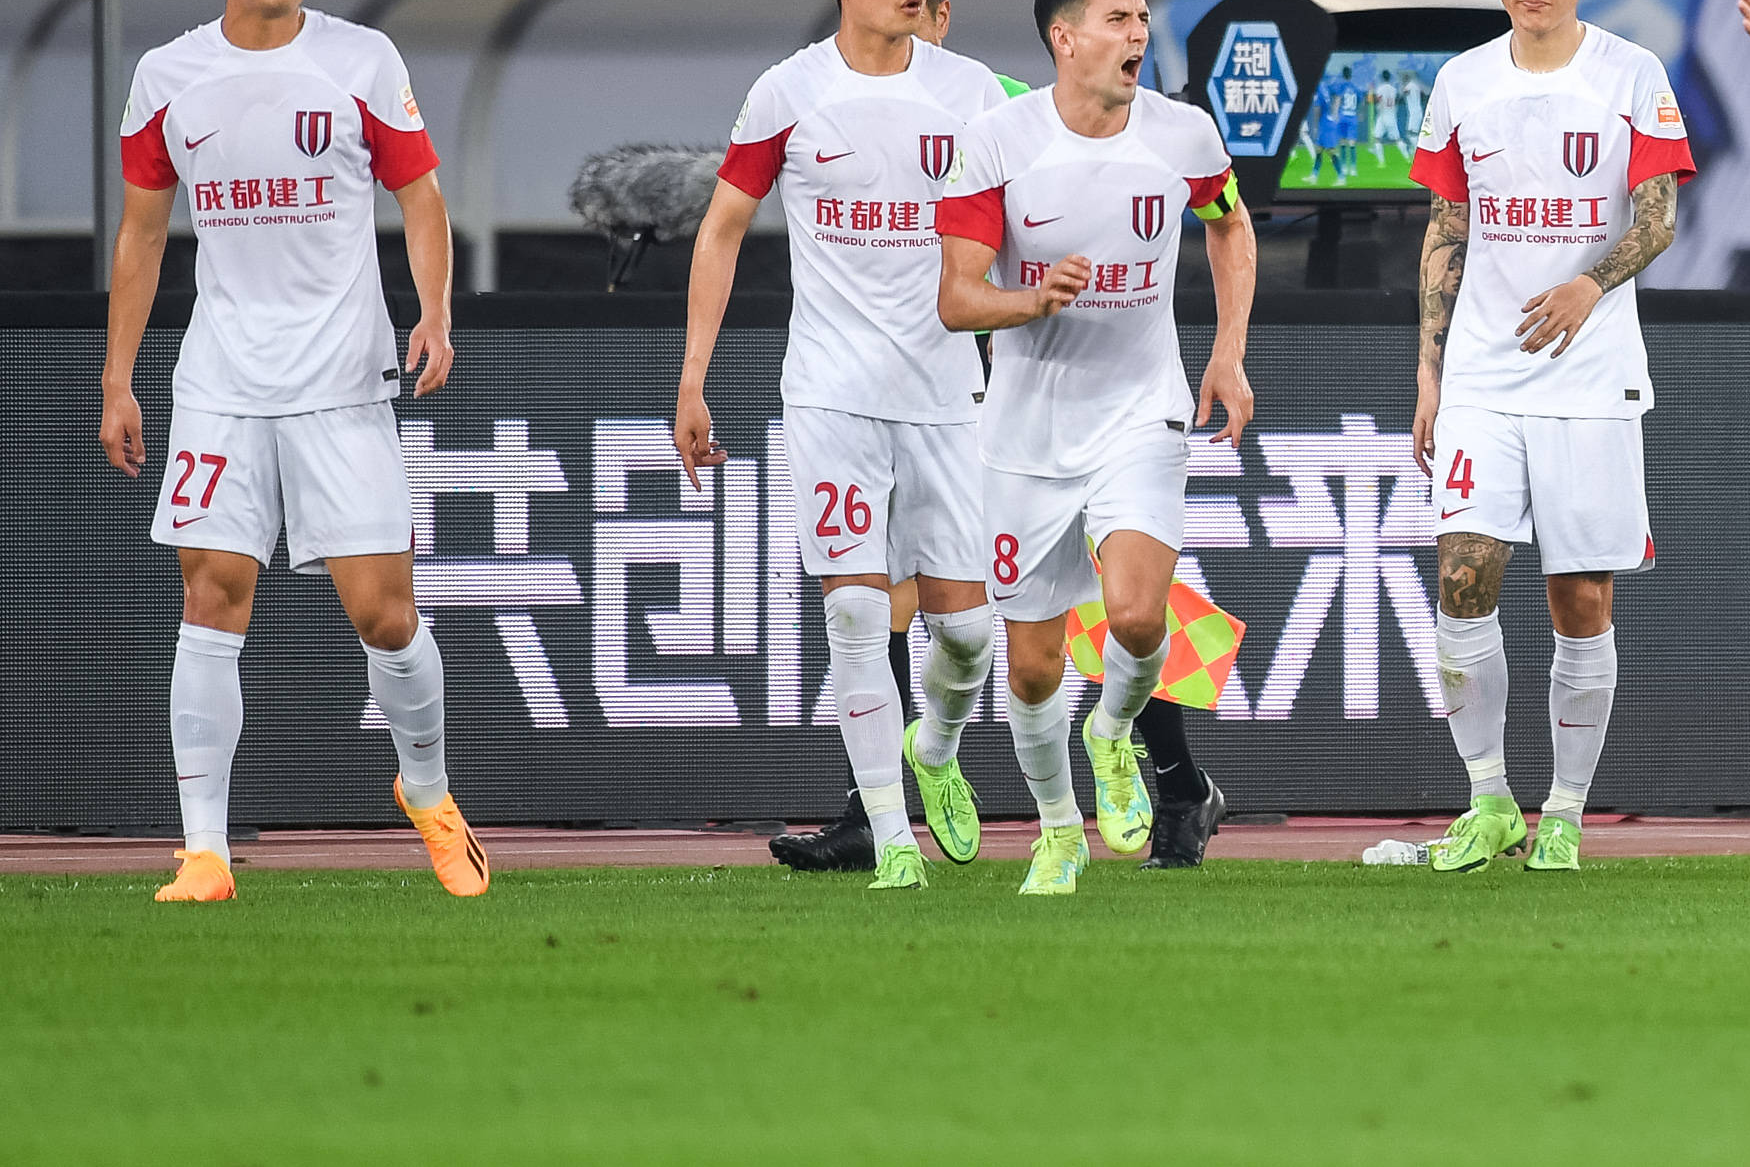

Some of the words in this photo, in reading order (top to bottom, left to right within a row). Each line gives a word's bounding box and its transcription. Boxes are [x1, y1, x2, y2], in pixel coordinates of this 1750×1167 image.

[1232, 42, 1271, 76] 共创
[1224, 79, 1280, 114] 新未来
[195, 176, 334, 211] 成都建工
[198, 216, 249, 228] CHENGDU
[253, 211, 336, 225] CONSTRUCTION
[1478, 196, 1608, 227] 成都建工
[814, 232, 866, 246] CHENGDU
[870, 236, 942, 248] CONSTRUCTIO
[1526, 234, 1607, 244] CONSTRUCTION
[1020, 258, 1159, 293] 成建工
[1075, 293, 1159, 309] CONSTRUCTION
[171, 450, 227, 509] 27
[1446, 450, 1475, 499] 4
[815, 481, 872, 537] 26
[993, 533, 1019, 585] 8
